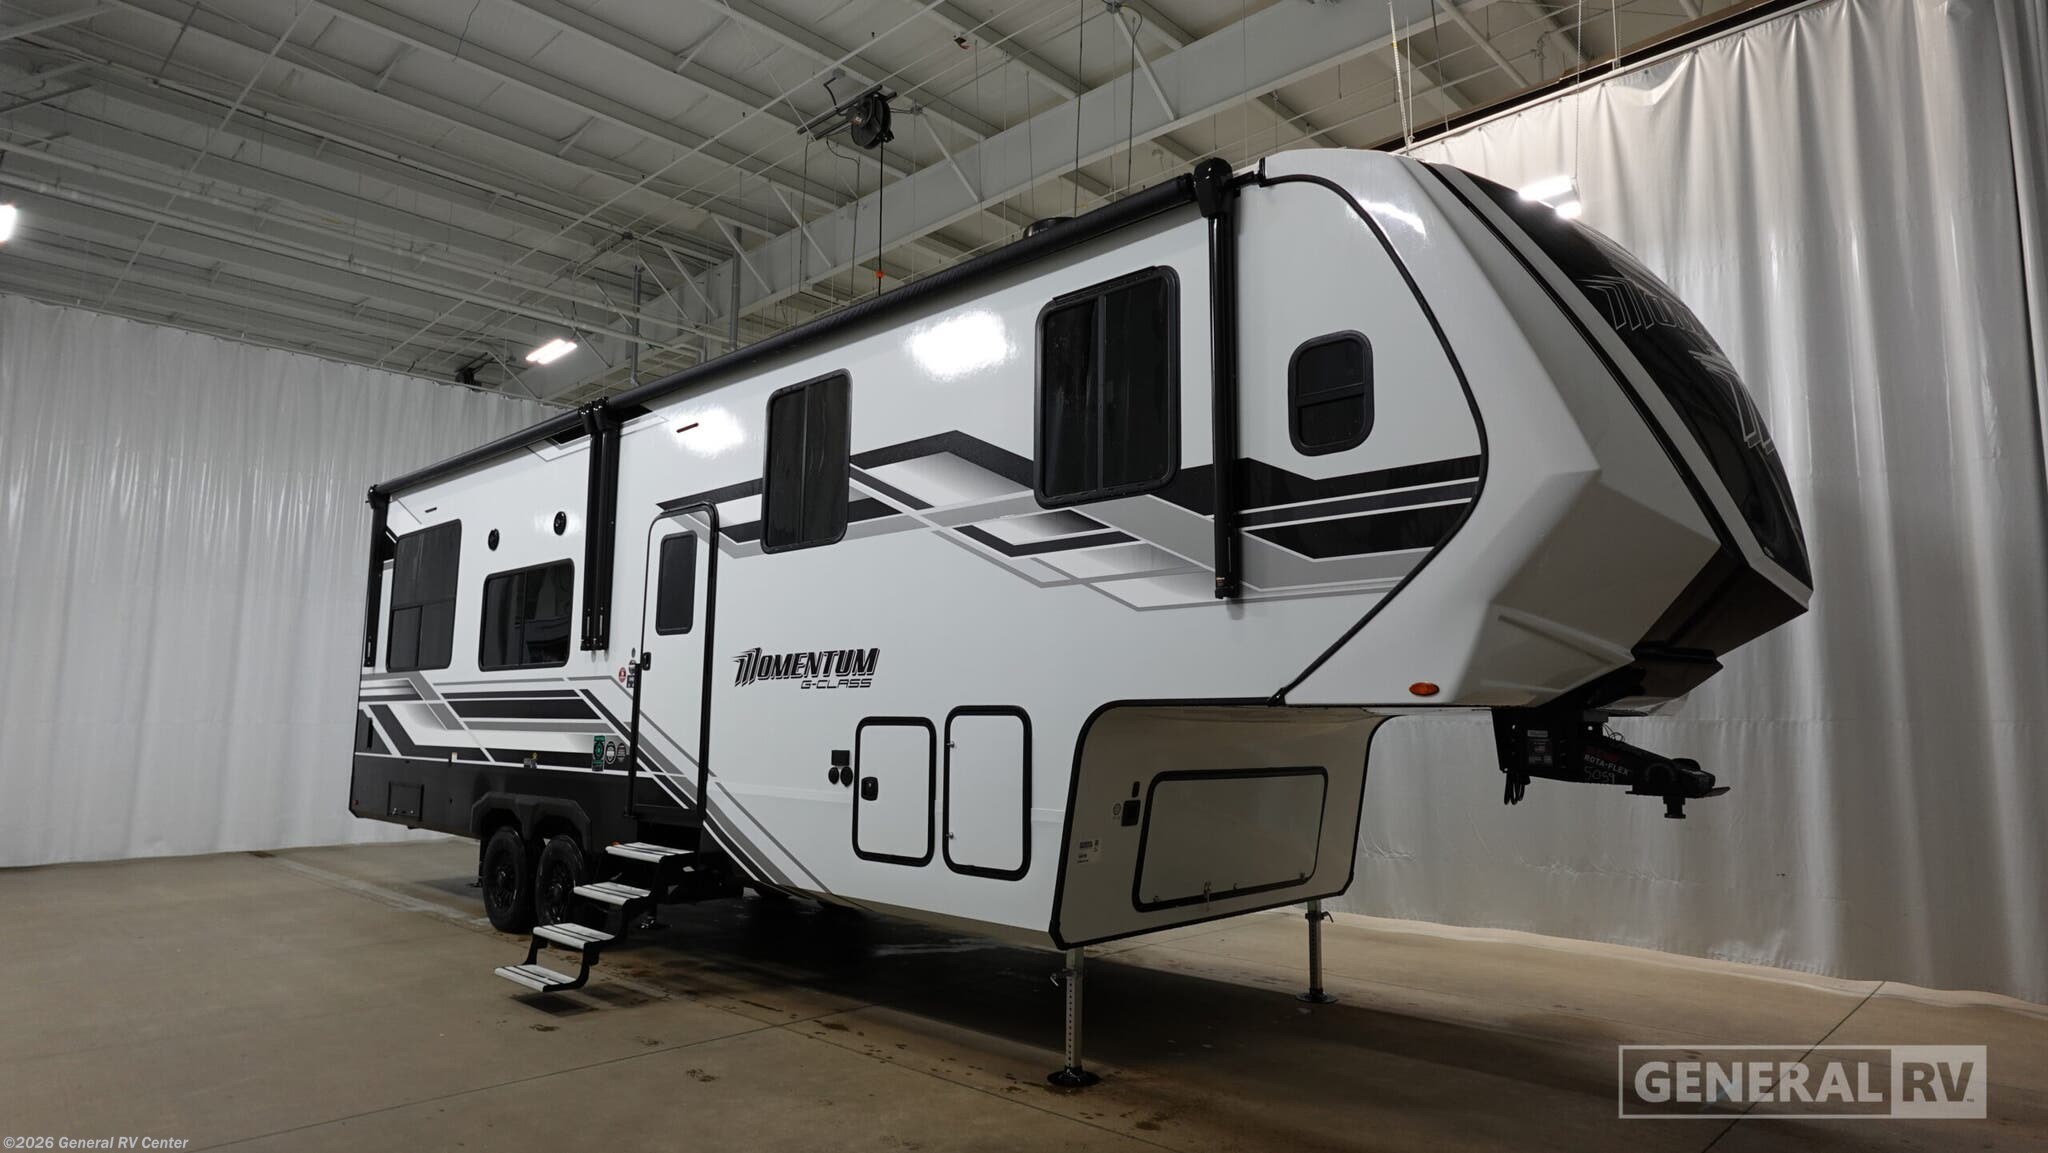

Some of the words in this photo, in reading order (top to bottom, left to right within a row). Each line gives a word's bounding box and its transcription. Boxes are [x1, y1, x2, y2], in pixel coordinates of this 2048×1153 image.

[732, 647, 880, 687] MOMENTUM
[800, 678, 872, 689] G-CLASS
[1583, 754, 1630, 776] ROTA-FLEX
